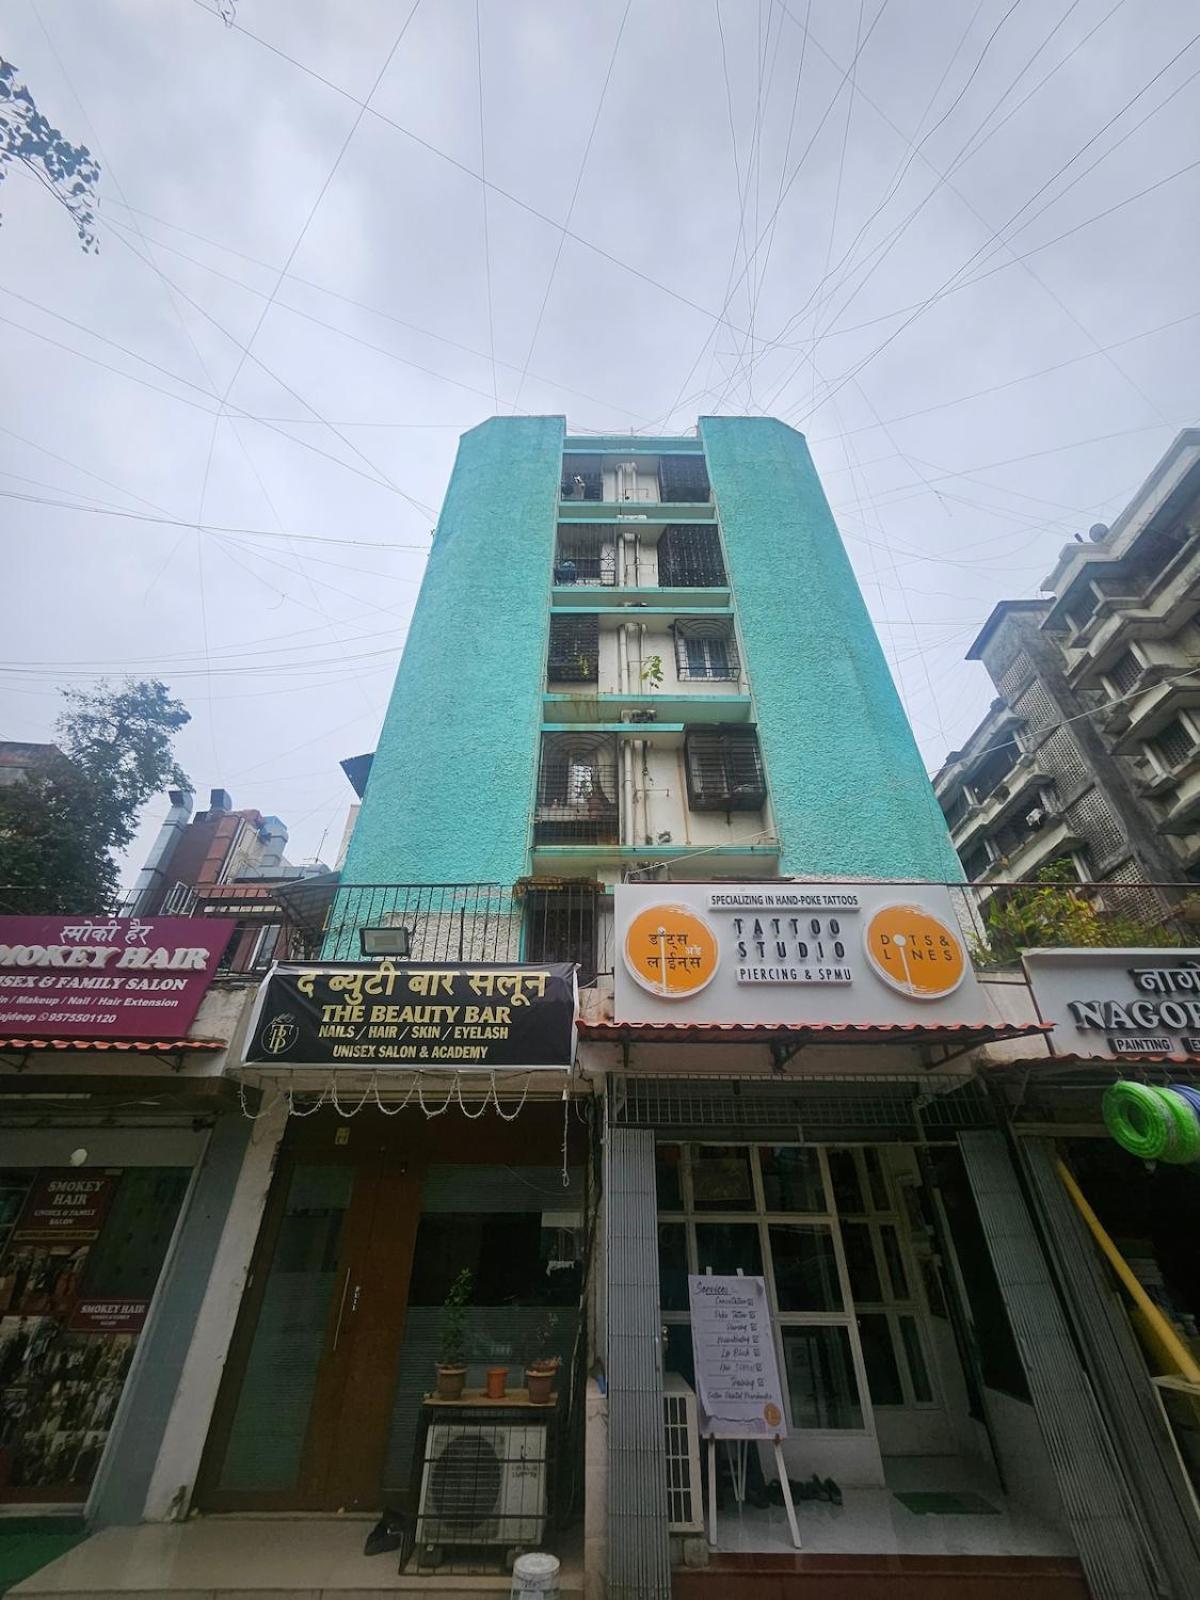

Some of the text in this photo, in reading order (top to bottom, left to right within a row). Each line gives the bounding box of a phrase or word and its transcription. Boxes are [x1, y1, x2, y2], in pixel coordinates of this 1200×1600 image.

[711, 895, 858, 905] SPECIALIZING IN HAND-POKE TATTOOS
[60, 918, 154, 945] स्मोकी हैर
[734, 918, 840, 935] TATTOO
[738, 941, 845, 958] STUDIO
[115, 947, 210, 970] HAIR
[740, 968, 851, 980] PIERCING & SPMU
[55, 977, 126, 990] FAMILY
[126, 979, 188, 991] SALON
[297, 970, 323, 998] द
[408, 970, 460, 996] बार
[466, 971, 551, 1006] सलून
[16, 997, 59, 1006] Makeup
[67, 997, 91, 1005] Nail
[97, 998, 122, 1006] Hair
[123, 998, 178, 1007] Extension
[321, 1005, 512, 1024] THE BEAUTY BAR
[318, 1025, 354, 1038] NAILS
[368, 1026, 397, 1039] HAIR
[411, 1026, 440, 1039] SKIN
[454, 1027, 509, 1039] EYELASH
[333, 1045, 488, 1059] UNISEX SALON & ACADEMY
[1117, 1039, 1171, 1051] PAINTING
[48, 1181, 104, 1192] SMOKEY
[52, 1194, 88, 1205] HAIR
